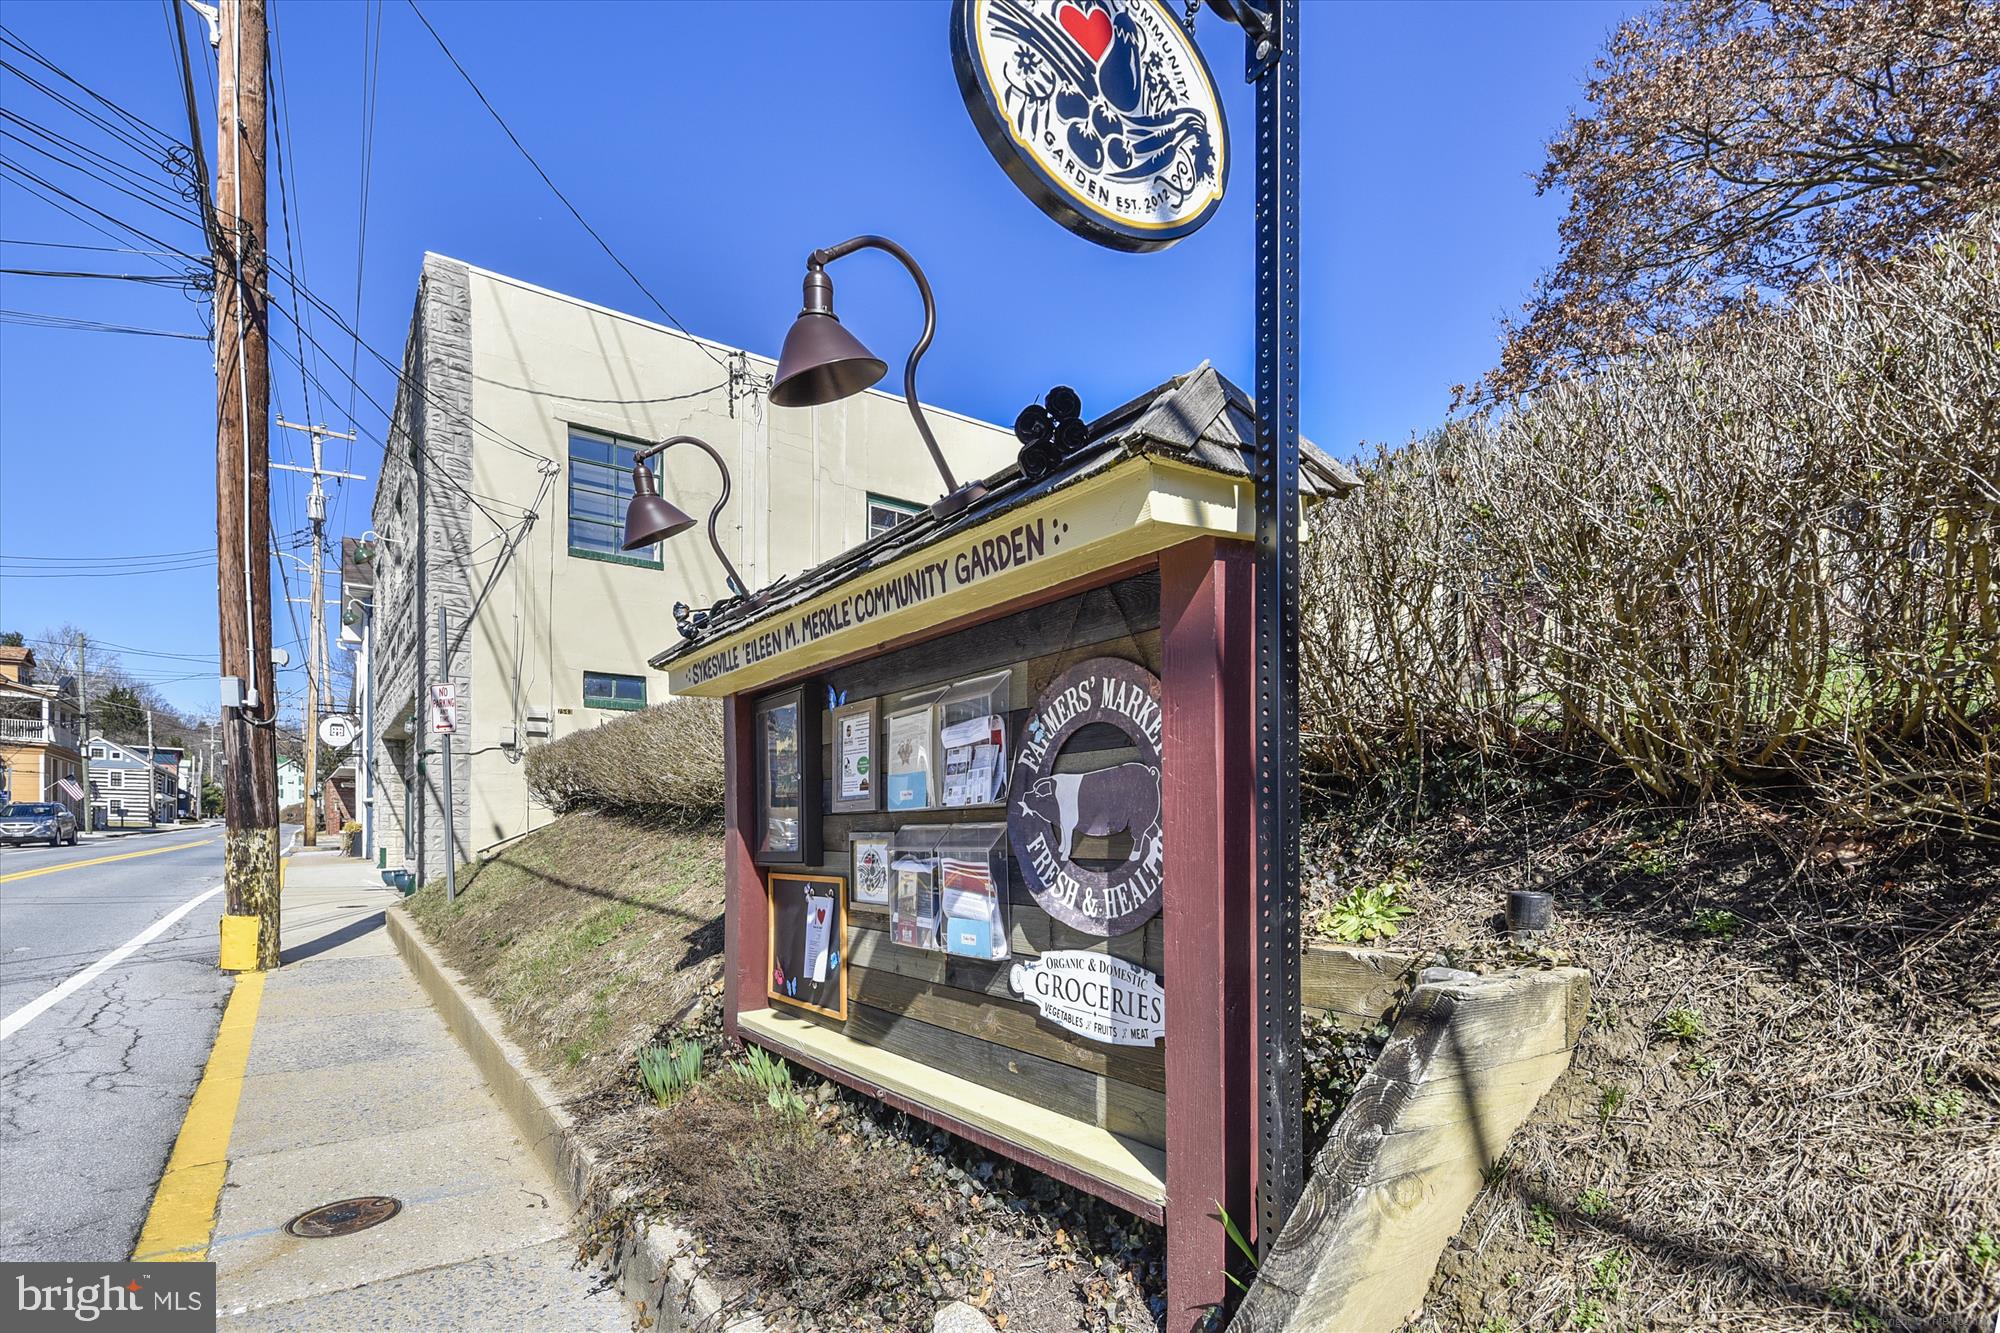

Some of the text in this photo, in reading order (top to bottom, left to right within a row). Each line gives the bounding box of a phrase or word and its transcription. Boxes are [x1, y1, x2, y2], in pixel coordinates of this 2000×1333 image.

[1130, 0, 1190, 100] OMMUNITY
[1044, 131, 1171, 210] GARDEN EST. 2012
[692, 646, 740, 684] SYKESVILLE
[785, 622, 800, 650] M.
[854, 558, 949, 623] COMMUNITY
[954, 518, 1045, 585] GARDEN
[432, 698, 455, 708] PARKING
[438, 687, 449, 697] NO
[1026, 832, 1080, 910] FRESH
[1082, 887, 1099, 918] &
[1035, 971, 1161, 1024] GROCERIES
[1045, 956, 1148, 990] ORGANIC & DOMESTIC
[1044, 1002, 1149, 1040] VEGETABLES FRUITS MEAT
